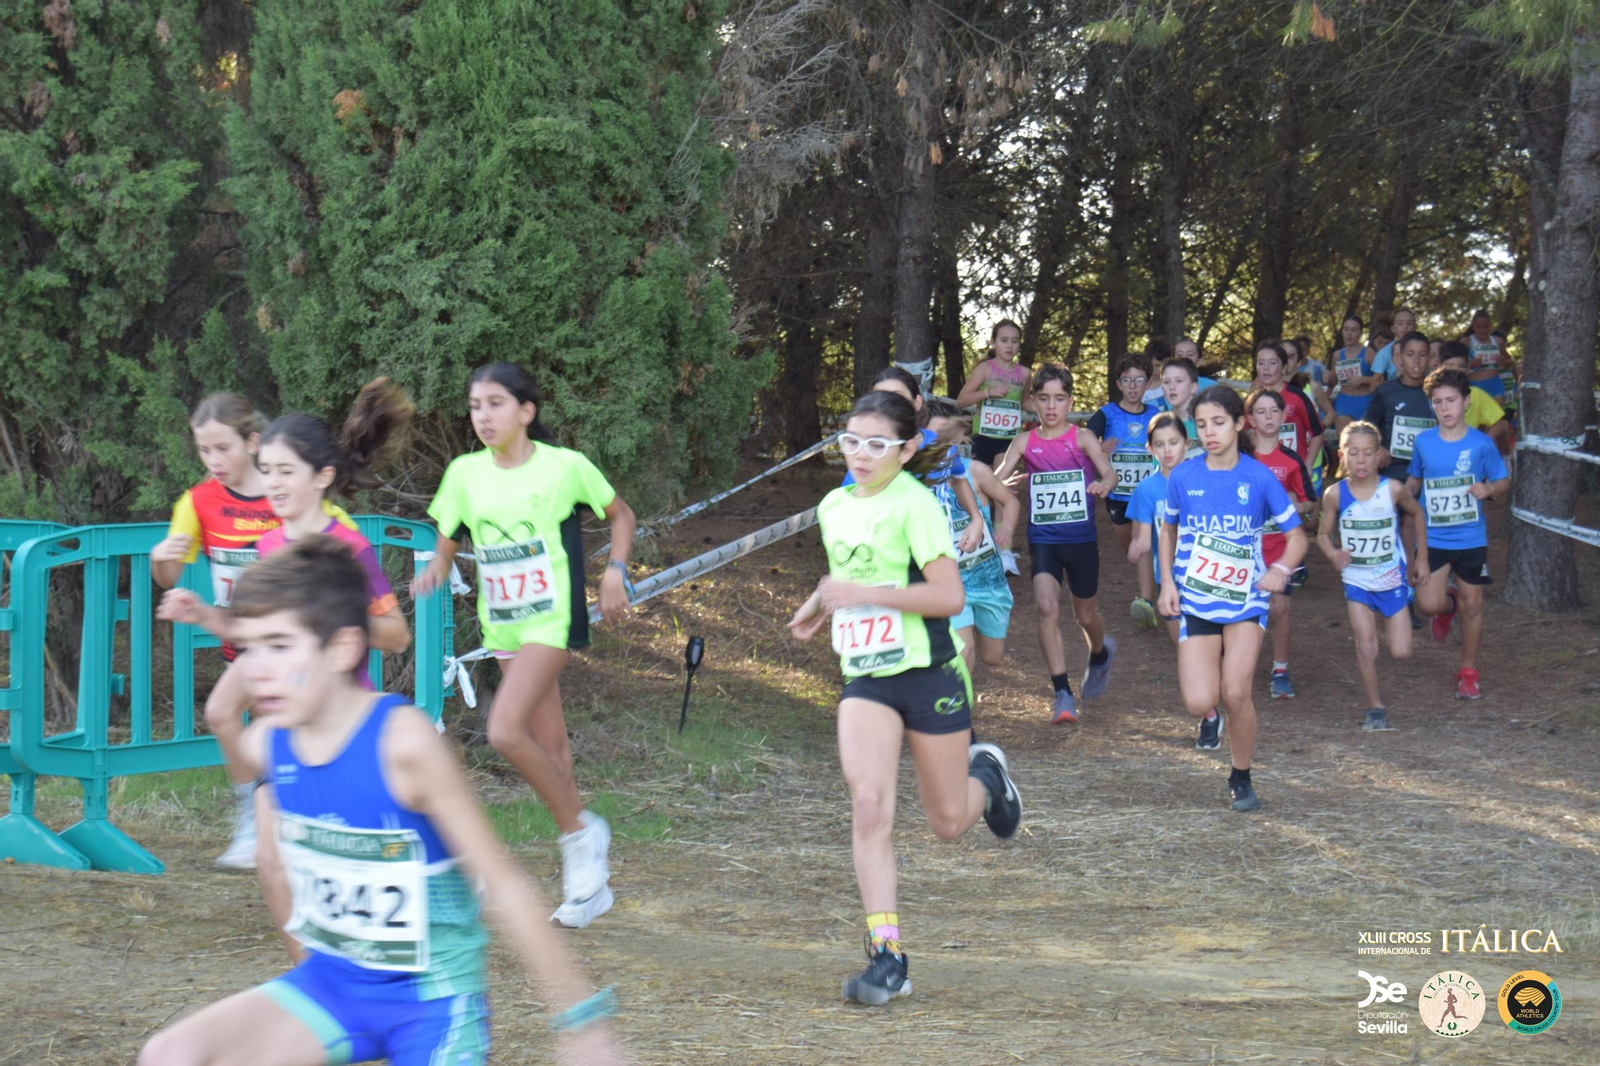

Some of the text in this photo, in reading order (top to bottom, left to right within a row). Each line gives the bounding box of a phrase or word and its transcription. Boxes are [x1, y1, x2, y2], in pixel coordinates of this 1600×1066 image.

[984, 412, 1019, 428] 5067
[1396, 432, 1416, 447] 58
[1036, 490, 1082, 510] 5744
[1430, 494, 1473, 512] 5731
[1186, 514, 1252, 534] CHAPIN
[1347, 535, 1392, 553] 5776
[1195, 555, 1249, 586] 7129
[484, 568, 549, 602] 7173
[838, 615, 896, 650] 7172
